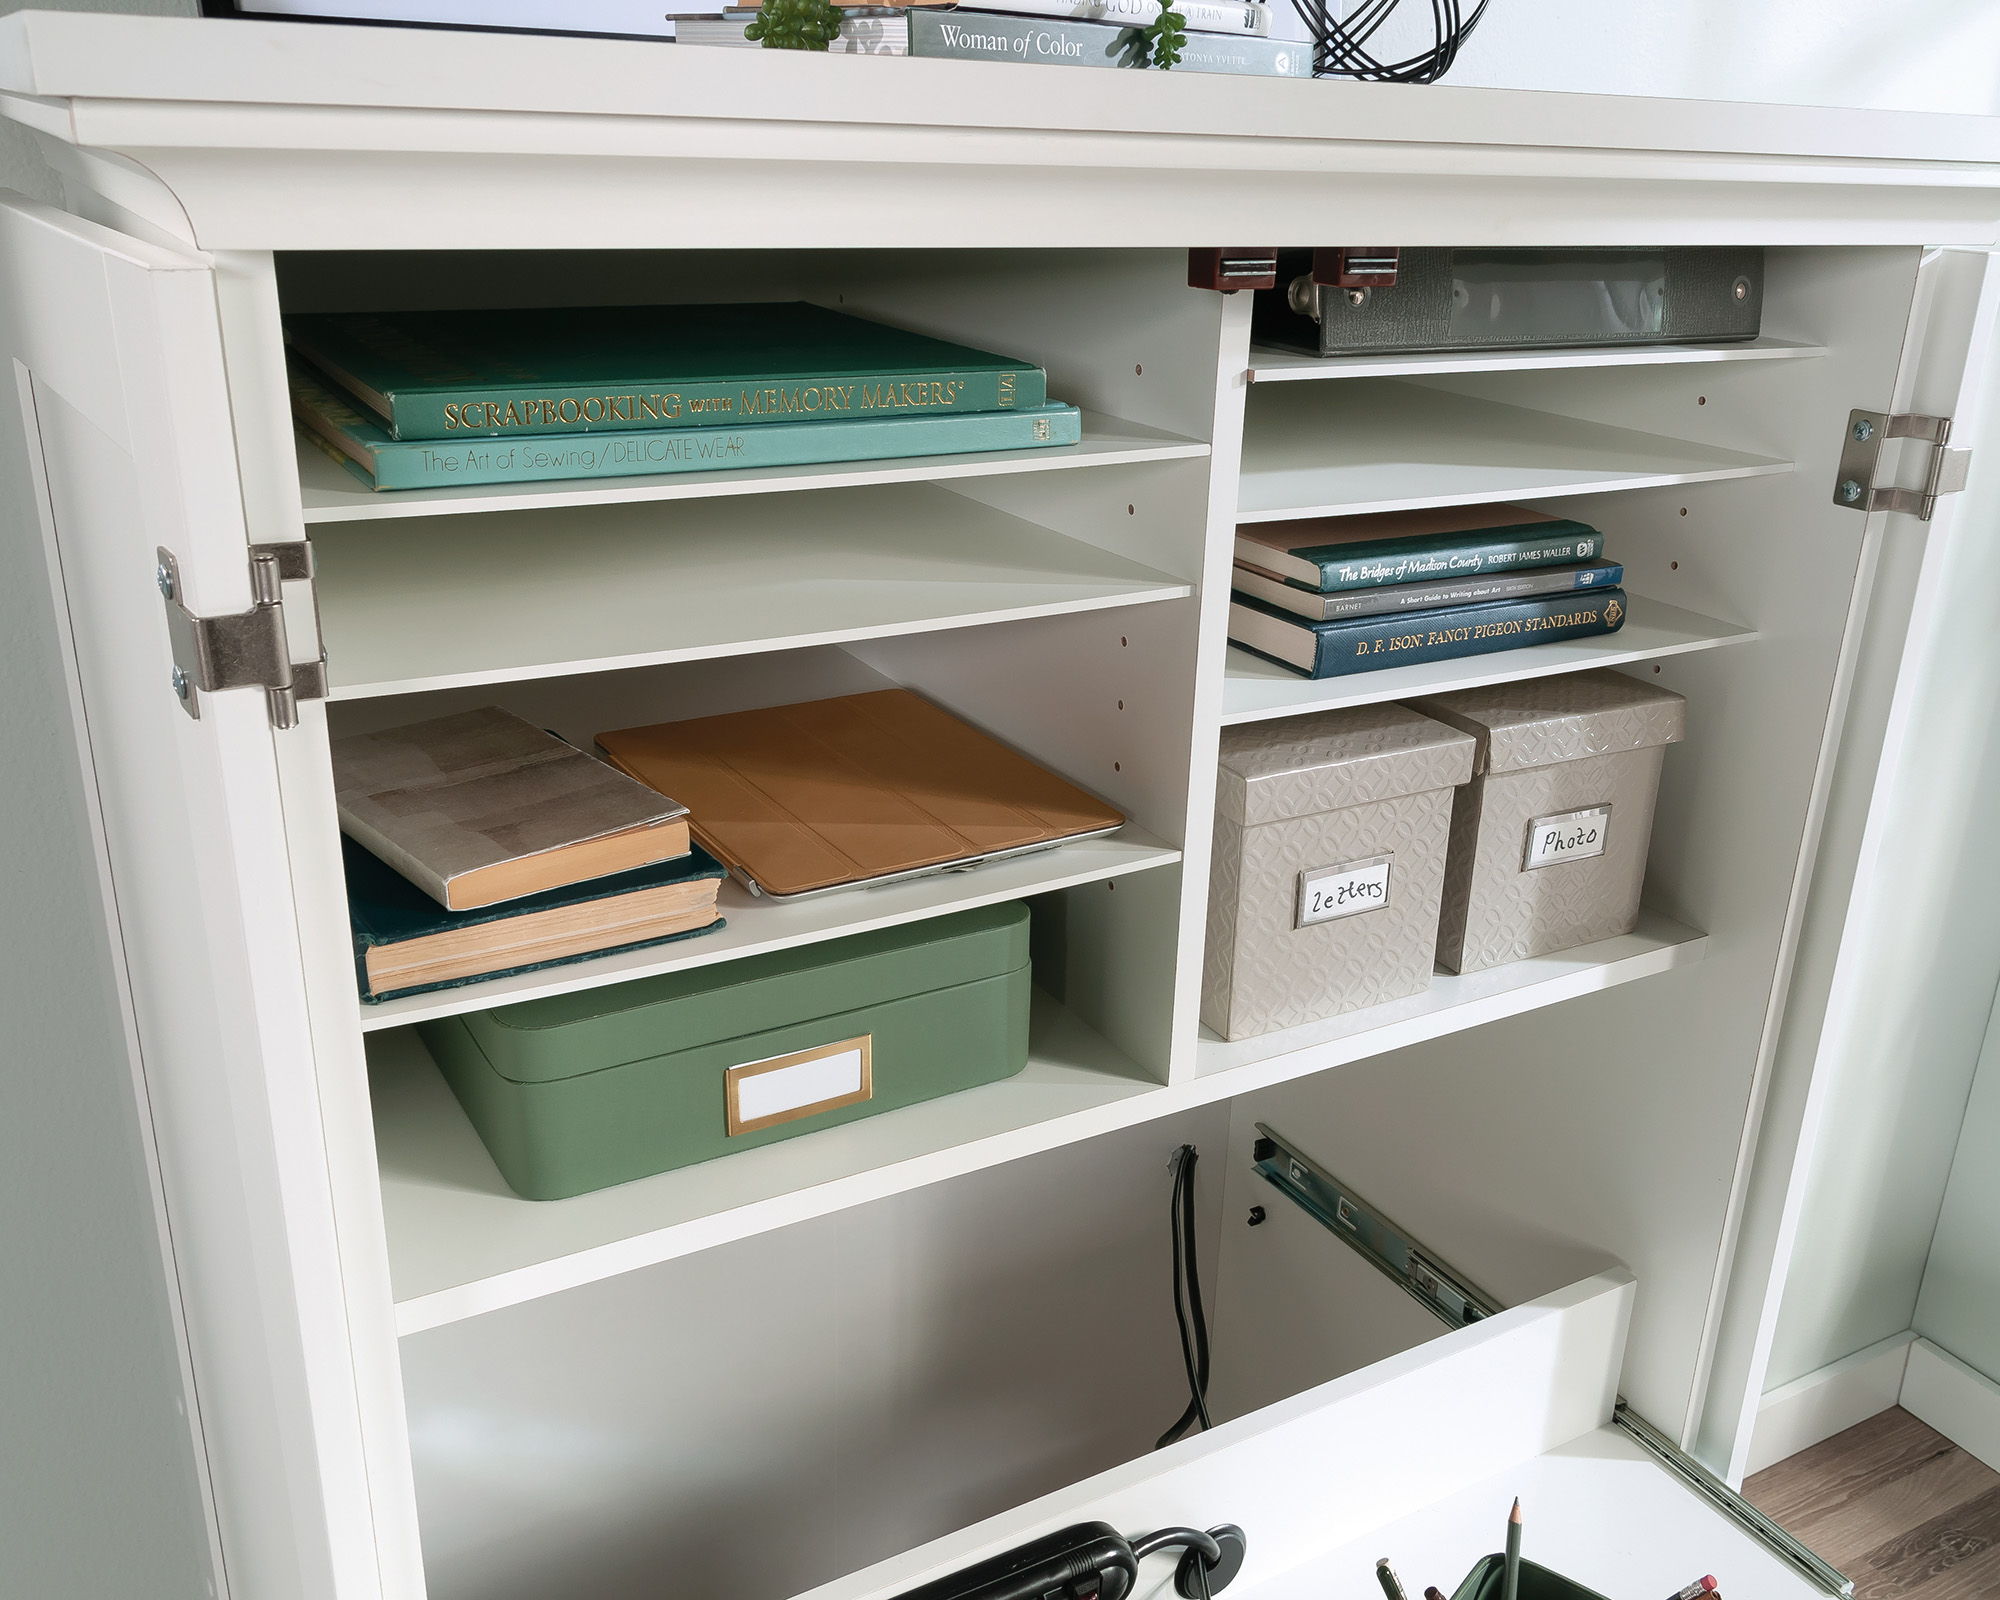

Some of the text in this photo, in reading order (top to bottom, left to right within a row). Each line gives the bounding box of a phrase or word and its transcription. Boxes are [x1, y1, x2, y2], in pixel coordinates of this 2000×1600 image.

[1196, 7, 1223, 21] TRAIN
[939, 24, 1083, 59] Woman of Color
[444, 393, 683, 430] SCRAPBOOKING
[689, 398, 732, 413] WITH
[738, 385, 855, 415] MEMORY
[421, 450, 459, 472] The
[465, 449, 489, 470] Art
[496, 448, 515, 469] of
[697, 436, 745, 458] WEAR
[1339, 554, 1483, 583] The Bridges of Madison County
[1488, 554, 1517, 565] ROBERT
[1518, 550, 1541, 562] JAMES
[1543, 547, 1571, 558] WALLER
[1336, 602, 1362, 612] BARNET
[1406, 596, 1423, 604] Short
[1424, 594, 1441, 602] Guide
[1450, 590, 1472, 599] Writing
[1473, 588, 1490, 596] about
[1356, 641, 1370, 656] D.
[1374, 639, 1385, 653] F.
[1427, 627, 1472, 646] FANCY
[1473, 620, 1523, 639] PIGEON
[1524, 610, 1598, 632] STANDARDS
